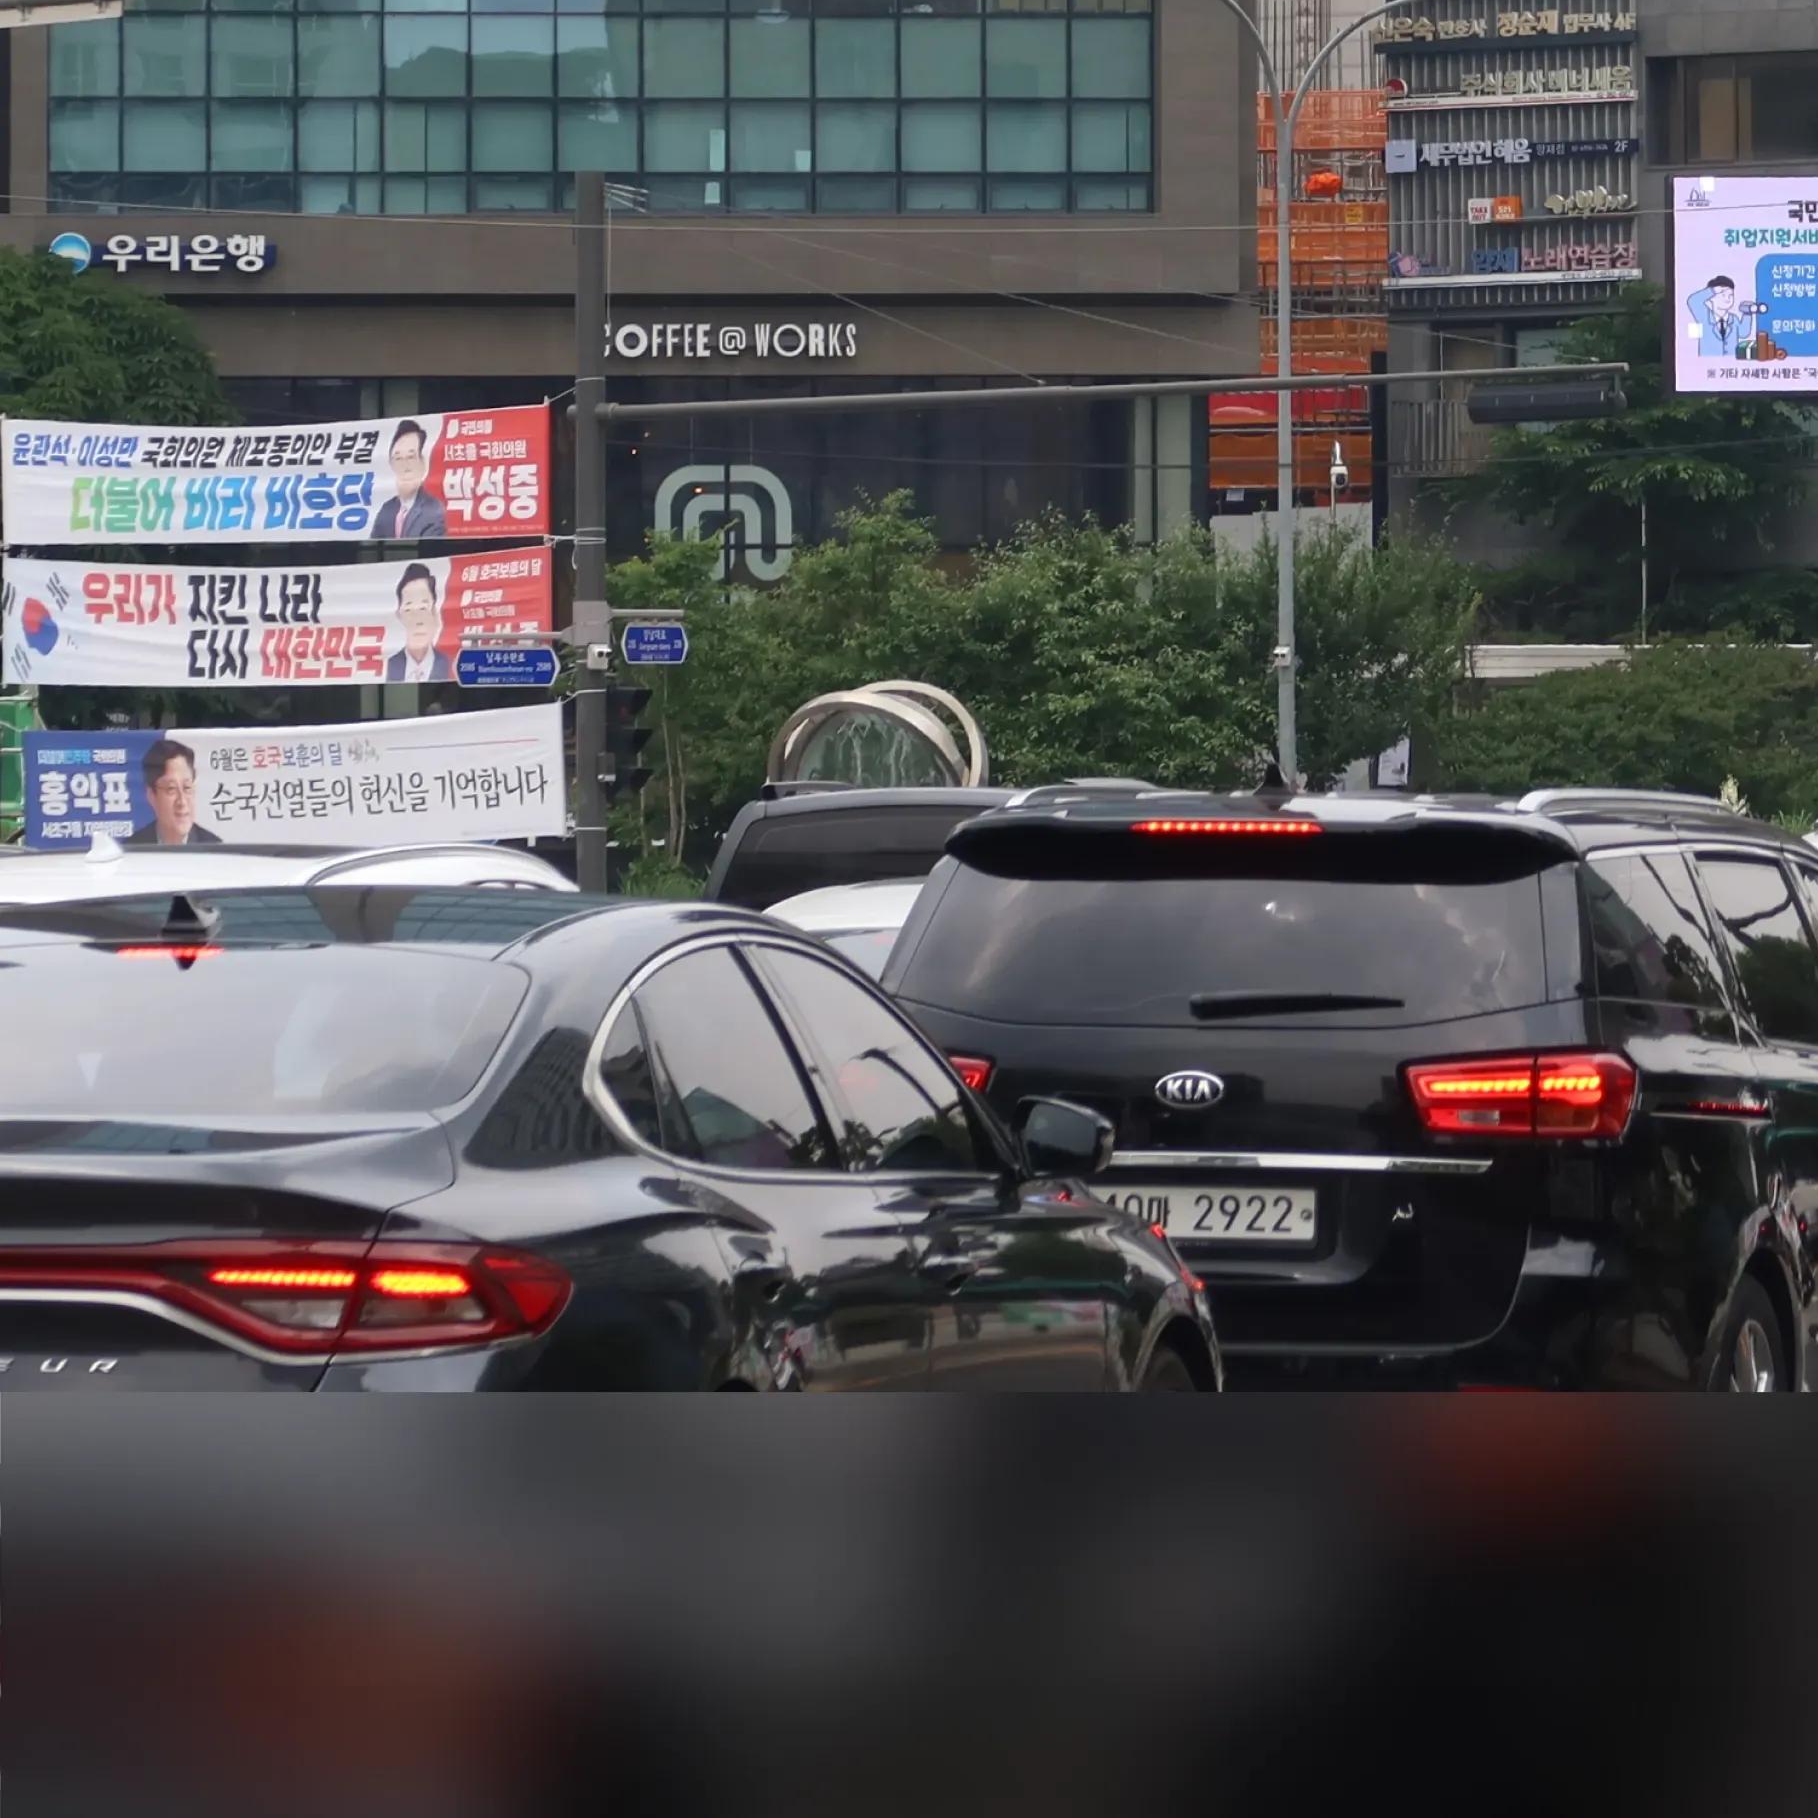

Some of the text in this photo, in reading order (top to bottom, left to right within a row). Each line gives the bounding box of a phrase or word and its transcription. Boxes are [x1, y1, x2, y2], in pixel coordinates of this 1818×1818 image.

[1419, 139, 1493, 167] 세무법인
[1614, 139, 1629, 153] 2F
[101, 233, 268, 273] 우리은행
[1520, 243, 1638, 271] 노래연습장
[1771, 265, 1816, 280] 신청기간
[604, 322, 711, 359] OFFEE
[755, 322, 857, 358] WORKS
[1771, 319, 1816, 334] 문의전화
[141, 435, 226, 469] 국회의원
[225, 432, 332, 468] 체포동의안
[333, 429, 380, 465] 부결
[479, 438, 528, 461] 국회의원
[69, 471, 376, 534] 더불어 비리 비호당
[442, 463, 540, 523] 박성중
[81, 572, 324, 626] 우리가 지킨 나라
[186, 624, 386, 680] 다시 대한민국
[209, 741, 343, 772] 6월은 호국보훈의 달
[39, 770, 132, 816] 홍익표
[210, 763, 550, 822] 순국선열들의 헌신을 기억합니다
[1166, 1078, 1212, 1102] KIA
[1193, 1194, 1294, 1233] 2922
